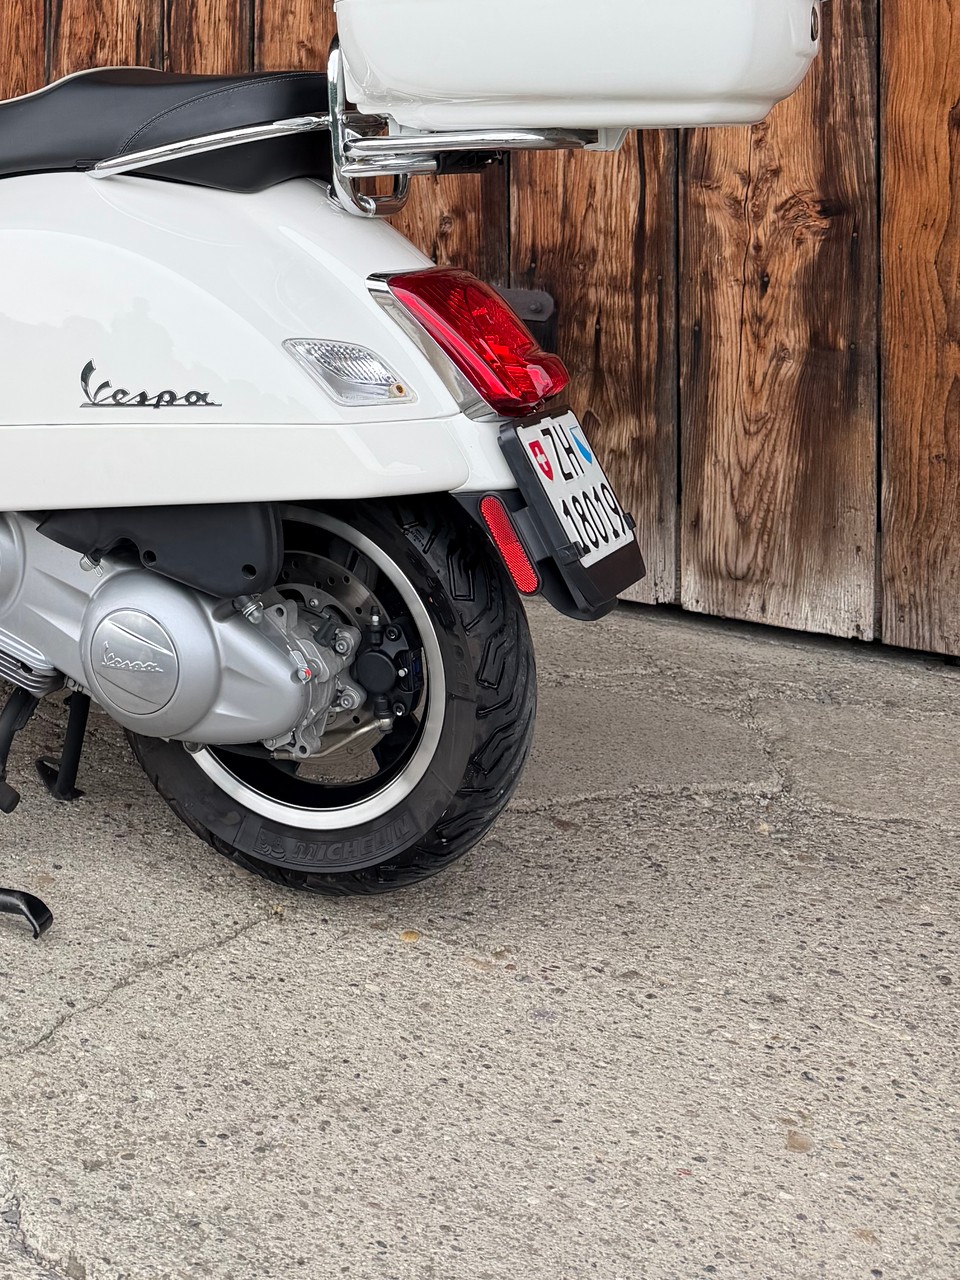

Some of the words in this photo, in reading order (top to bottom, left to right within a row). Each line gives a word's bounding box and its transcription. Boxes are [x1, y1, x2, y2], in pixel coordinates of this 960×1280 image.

[80, 358, 222, 409] Vespa
[541, 424, 585, 481] ZH
[562, 482, 626, 555] 18019
[101, 640, 164, 673] Vespa
[292, 812, 411, 861] MICHELIN
